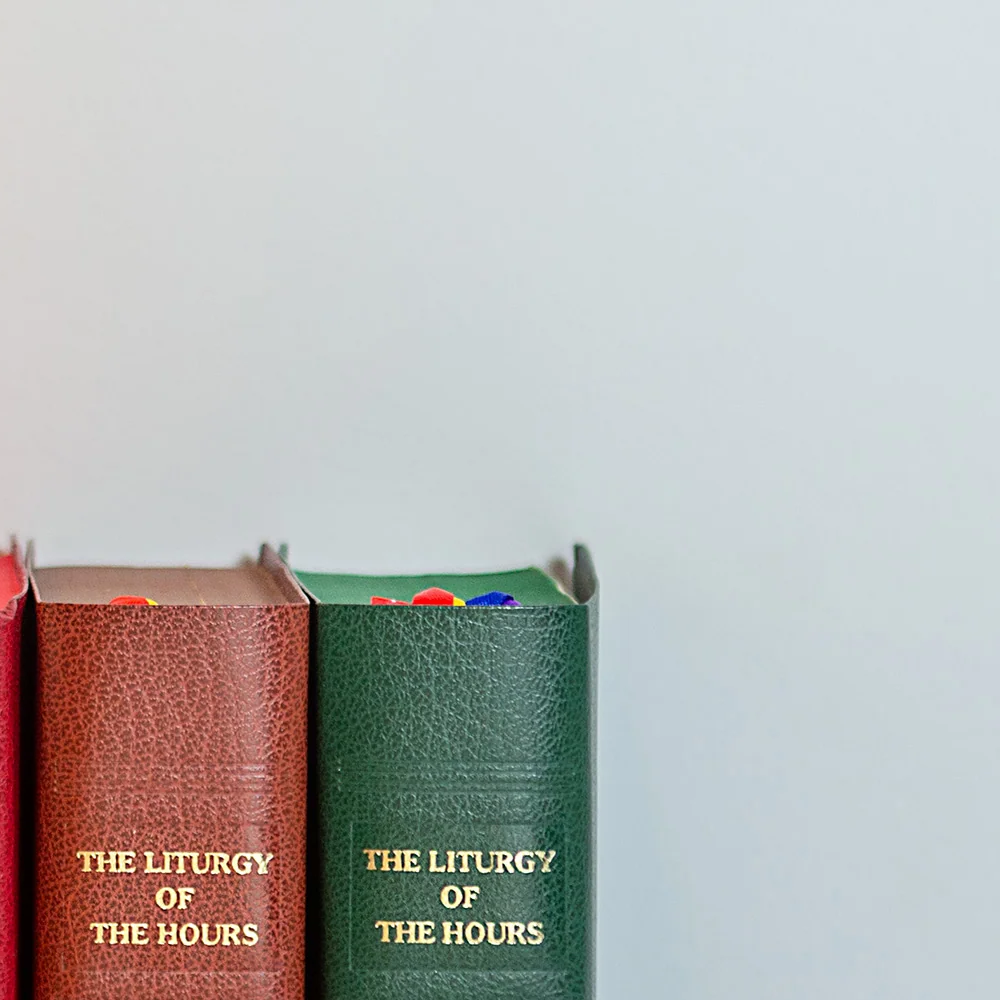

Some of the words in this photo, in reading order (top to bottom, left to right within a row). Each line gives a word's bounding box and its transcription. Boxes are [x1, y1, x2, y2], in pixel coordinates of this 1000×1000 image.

[76, 850, 137, 876] THE
[143, 850, 275, 877] LITURGY
[363, 849, 422, 874] THE
[428, 849, 557, 875] LITURGY
[155, 886, 196, 910] OF
[440, 884, 481, 909] OF
[89, 922, 150, 947] THE
[156, 922, 260, 947] HOURS
[374, 920, 437, 946] THE
[441, 920, 545, 946] HOURS
